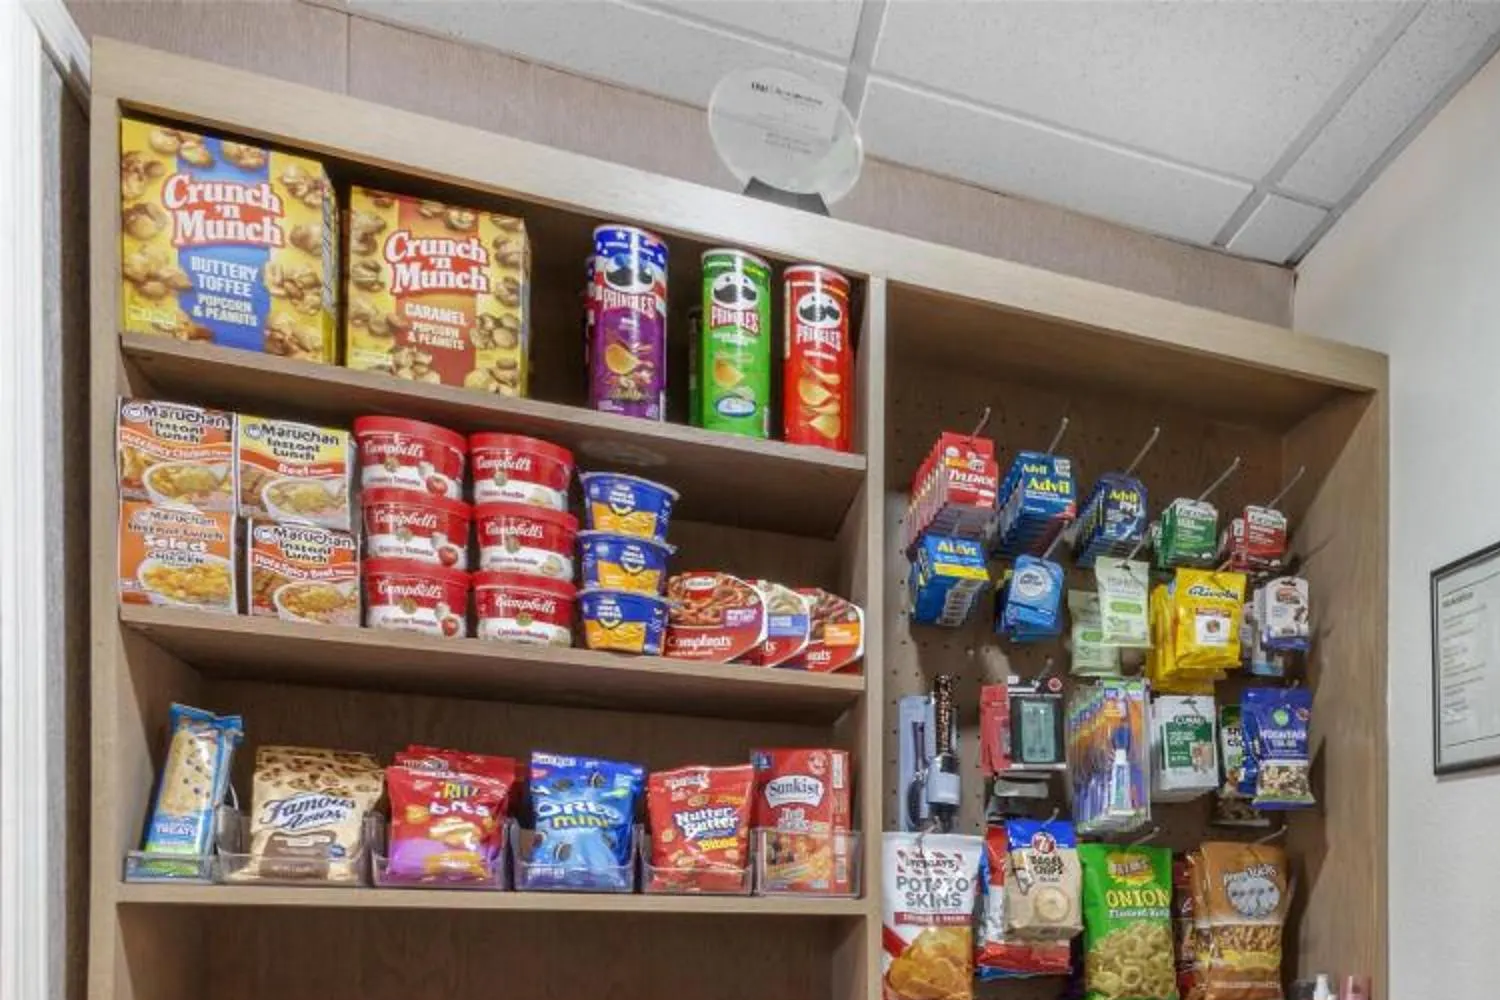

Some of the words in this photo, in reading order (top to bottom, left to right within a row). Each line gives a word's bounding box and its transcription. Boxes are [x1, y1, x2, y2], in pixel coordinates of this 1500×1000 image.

[163, 173, 282, 215] Crunch
[173, 209, 283, 247] Munch
[385, 232, 488, 264] Crunch
[190, 255, 259, 282] BUTTERY
[393, 261, 489, 293] Munch
[199, 274, 253, 299] TOFFEE
[198, 294, 254, 315] POPCORN
[404, 303, 468, 326] CARAMEL
[205, 307, 259, 327] PEANUTS
[711, 305, 760, 335] PRINGLES
[418, 334, 466, 352] PEANUTS
[144, 405, 226, 433] Maruchan
[149, 420, 205, 435] Instant
[155, 430, 200, 444] Lunch
[261, 423, 340, 447] Maruchan
[268, 438, 321, 454] Instant
[273, 449, 316, 462] Lunch
[948, 470, 996, 487] TYLENOL
[1028, 477, 1070, 494] Advil
[1109, 490, 1138, 503] Advil
[150, 511, 215, 527] Maruchan
[145, 536, 208, 553] Select
[273, 526, 352, 549] Maruchan
[279, 540, 333, 556] Instant
[285, 550, 328, 564] Lunch
[443, 781, 481, 799] RITZ
[769, 778, 820, 800] Sunkist
[261, 797, 356, 824] Famous
[282, 810, 342, 828] Amos
[676, 807, 734, 826] Nutter
[684, 815, 739, 838] Butter
[905, 891, 963, 908] SKINS
[1105, 888, 1169, 908] ONION
